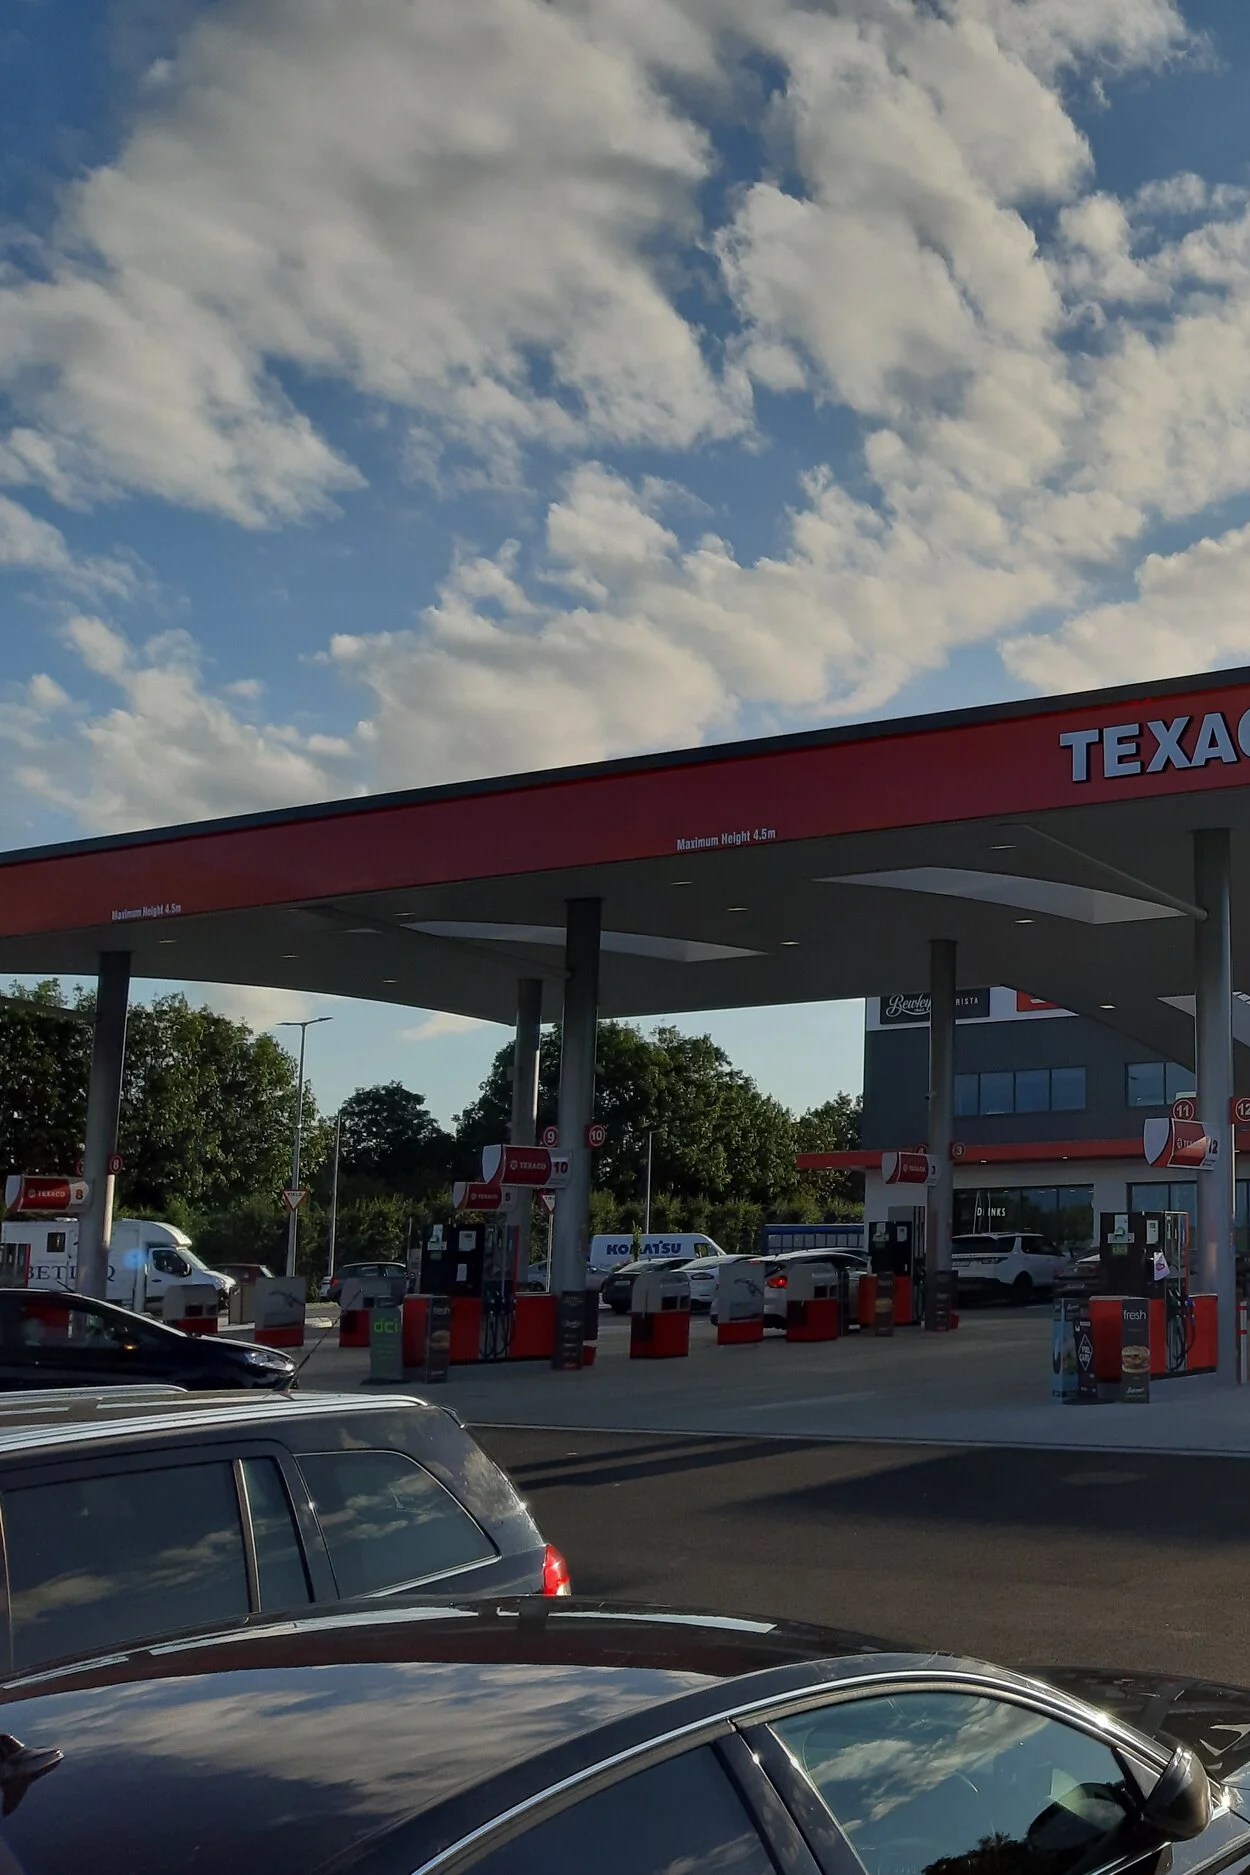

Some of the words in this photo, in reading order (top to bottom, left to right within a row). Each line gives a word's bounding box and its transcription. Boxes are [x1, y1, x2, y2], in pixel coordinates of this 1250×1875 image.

[676, 837, 719, 851] Maximum
[721, 831, 751, 846] Height
[753, 828, 776, 841] 4.5m
[111, 909, 142, 921] Maximum
[142, 904, 164, 917] Height
[885, 993, 931, 1017] Bewley
[955, 997, 979, 1006] RISTA
[1176, 1105, 1189, 1117] 11
[547, 1131, 555, 1144] 9
[592, 1130, 602, 1141] 10
[956, 1146, 963, 1156] 3
[1208, 1139, 1218, 1154] 12
[112, 1158, 120, 1171] 8
[553, 1161, 568, 1174] 10
[37, 1189, 66, 1198] TEXACO
[505, 1192, 511, 1202] 5
[1123, 1309, 1147, 1320] fresh
[373, 1317, 399, 1333] dci
